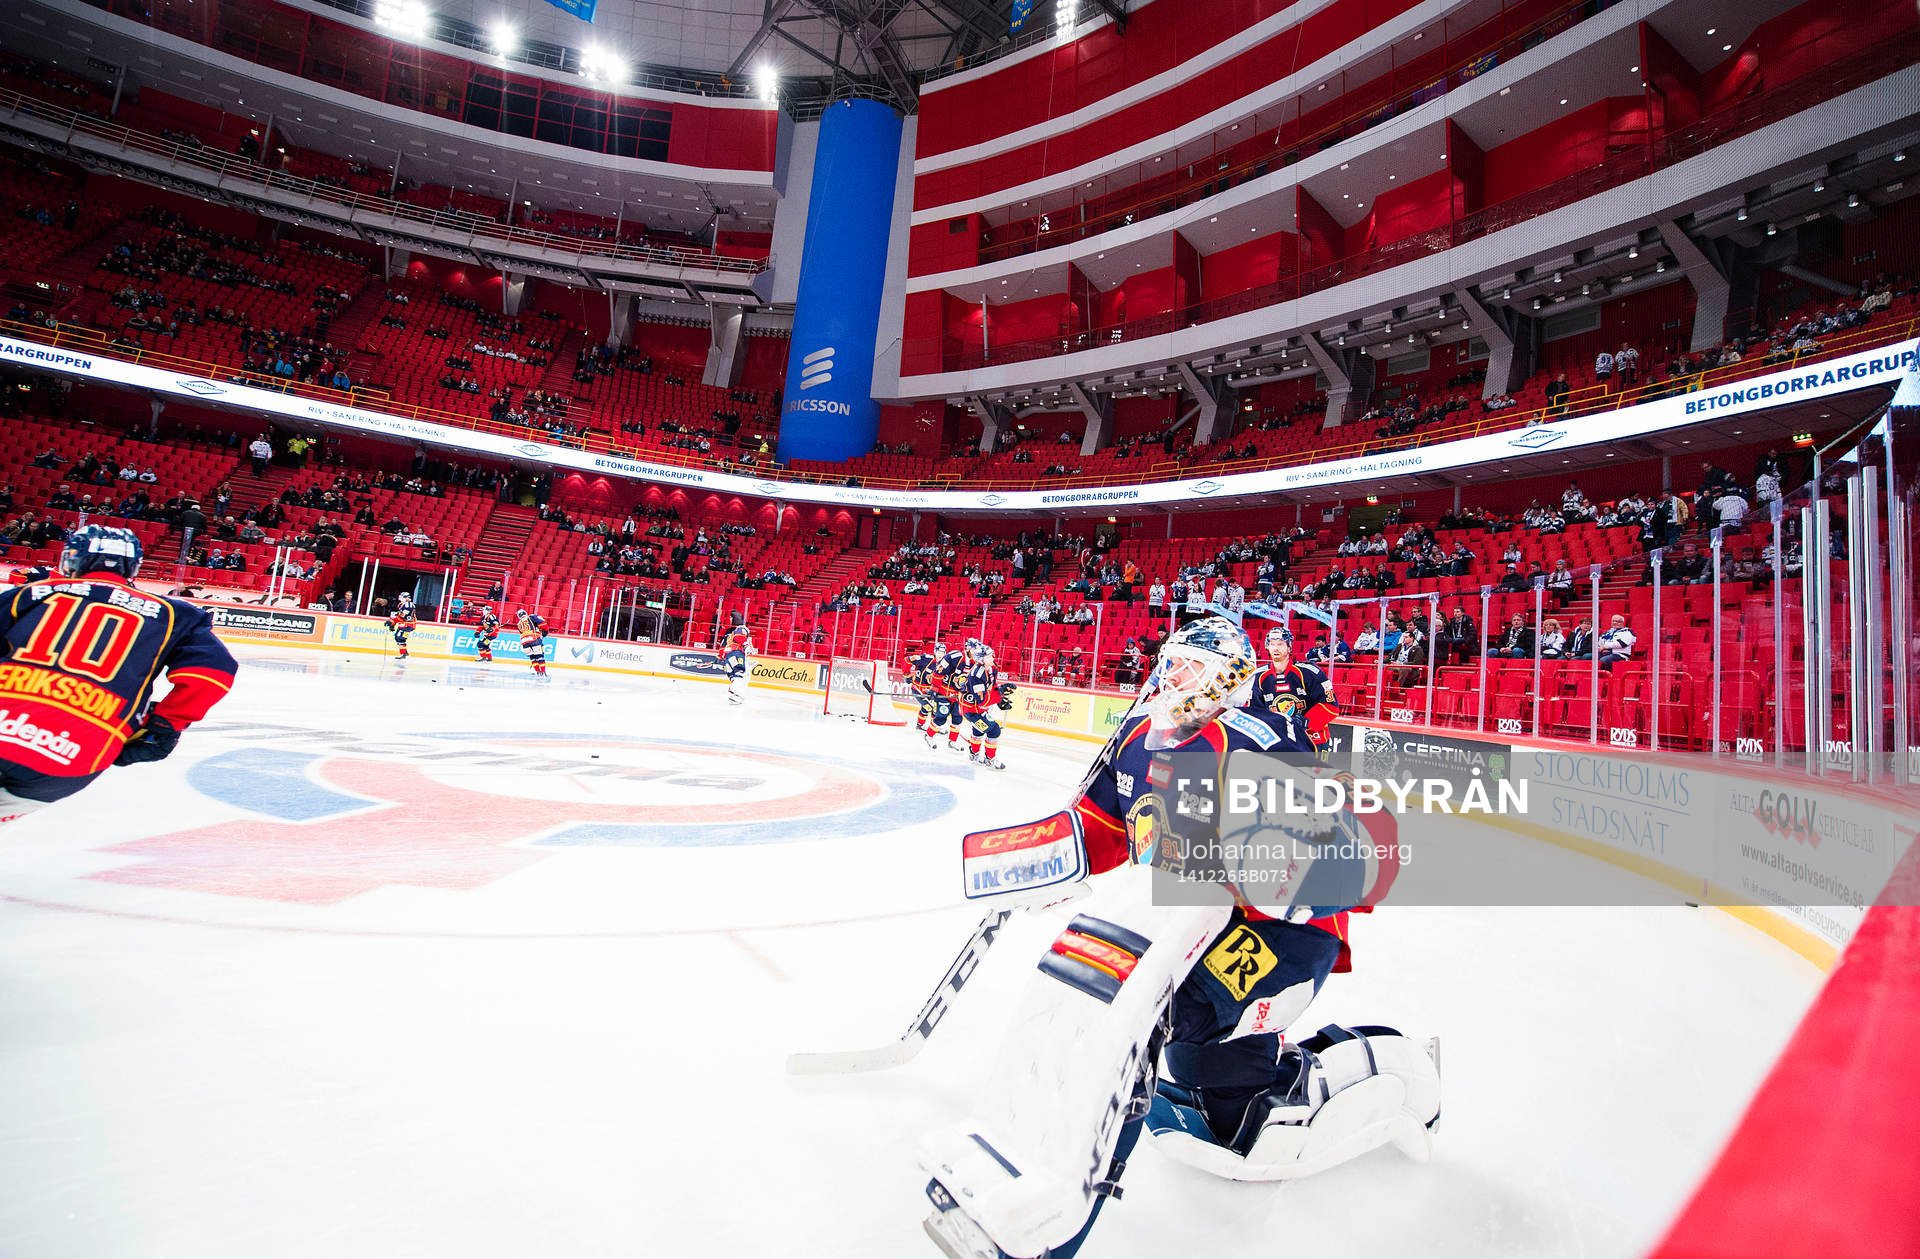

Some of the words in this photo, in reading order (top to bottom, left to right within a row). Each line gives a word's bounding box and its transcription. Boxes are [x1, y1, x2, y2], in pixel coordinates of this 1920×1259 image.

[308, 406, 324, 415] RIV
[332, 411, 381, 426] SANERING
[389, 423, 446, 438] HALTAGNING
[595, 459, 704, 482] BETONGBORRARGRUPPEN
[1286, 474, 1300, 482] RIV
[1306, 467, 1352, 480] SANERING
[1360, 457, 1423, 473] HALTAGNING
[1042, 490, 1139, 504] BETONGBORRARGRUPPEN
[213, 610, 312, 629] HYDROSCAND
[12, 592, 145, 683] 10
[600, 649, 644, 663] Mediatec
[0, 665, 121, 720] ERIKSSON
[1391, 708, 1414, 720] RYDS
[1498, 719, 1522, 731] RYDS
[1611, 727, 1637, 743] RYDS
[1736, 737, 1763, 755] RYDS
[1404, 742, 1486, 767] CERTINA
[1825, 740, 1851, 764] RYDS
[1534, 751, 1690, 806] STOCKHOLMS
[1552, 796, 1670, 854] STADSNÄT
[1759, 789, 1817, 836] GOLV
[1818, 813, 1858, 848] SERVICE
[1862, 829, 1874, 854] AB
[981, 821, 1057, 849] CCM
[1741, 843, 1864, 912] www.altagolvservice.se
[1742, 876, 1750, 889] Vi
[1761, 886, 1802, 918] medlemmar
[911, 909, 1012, 1040] CCM
